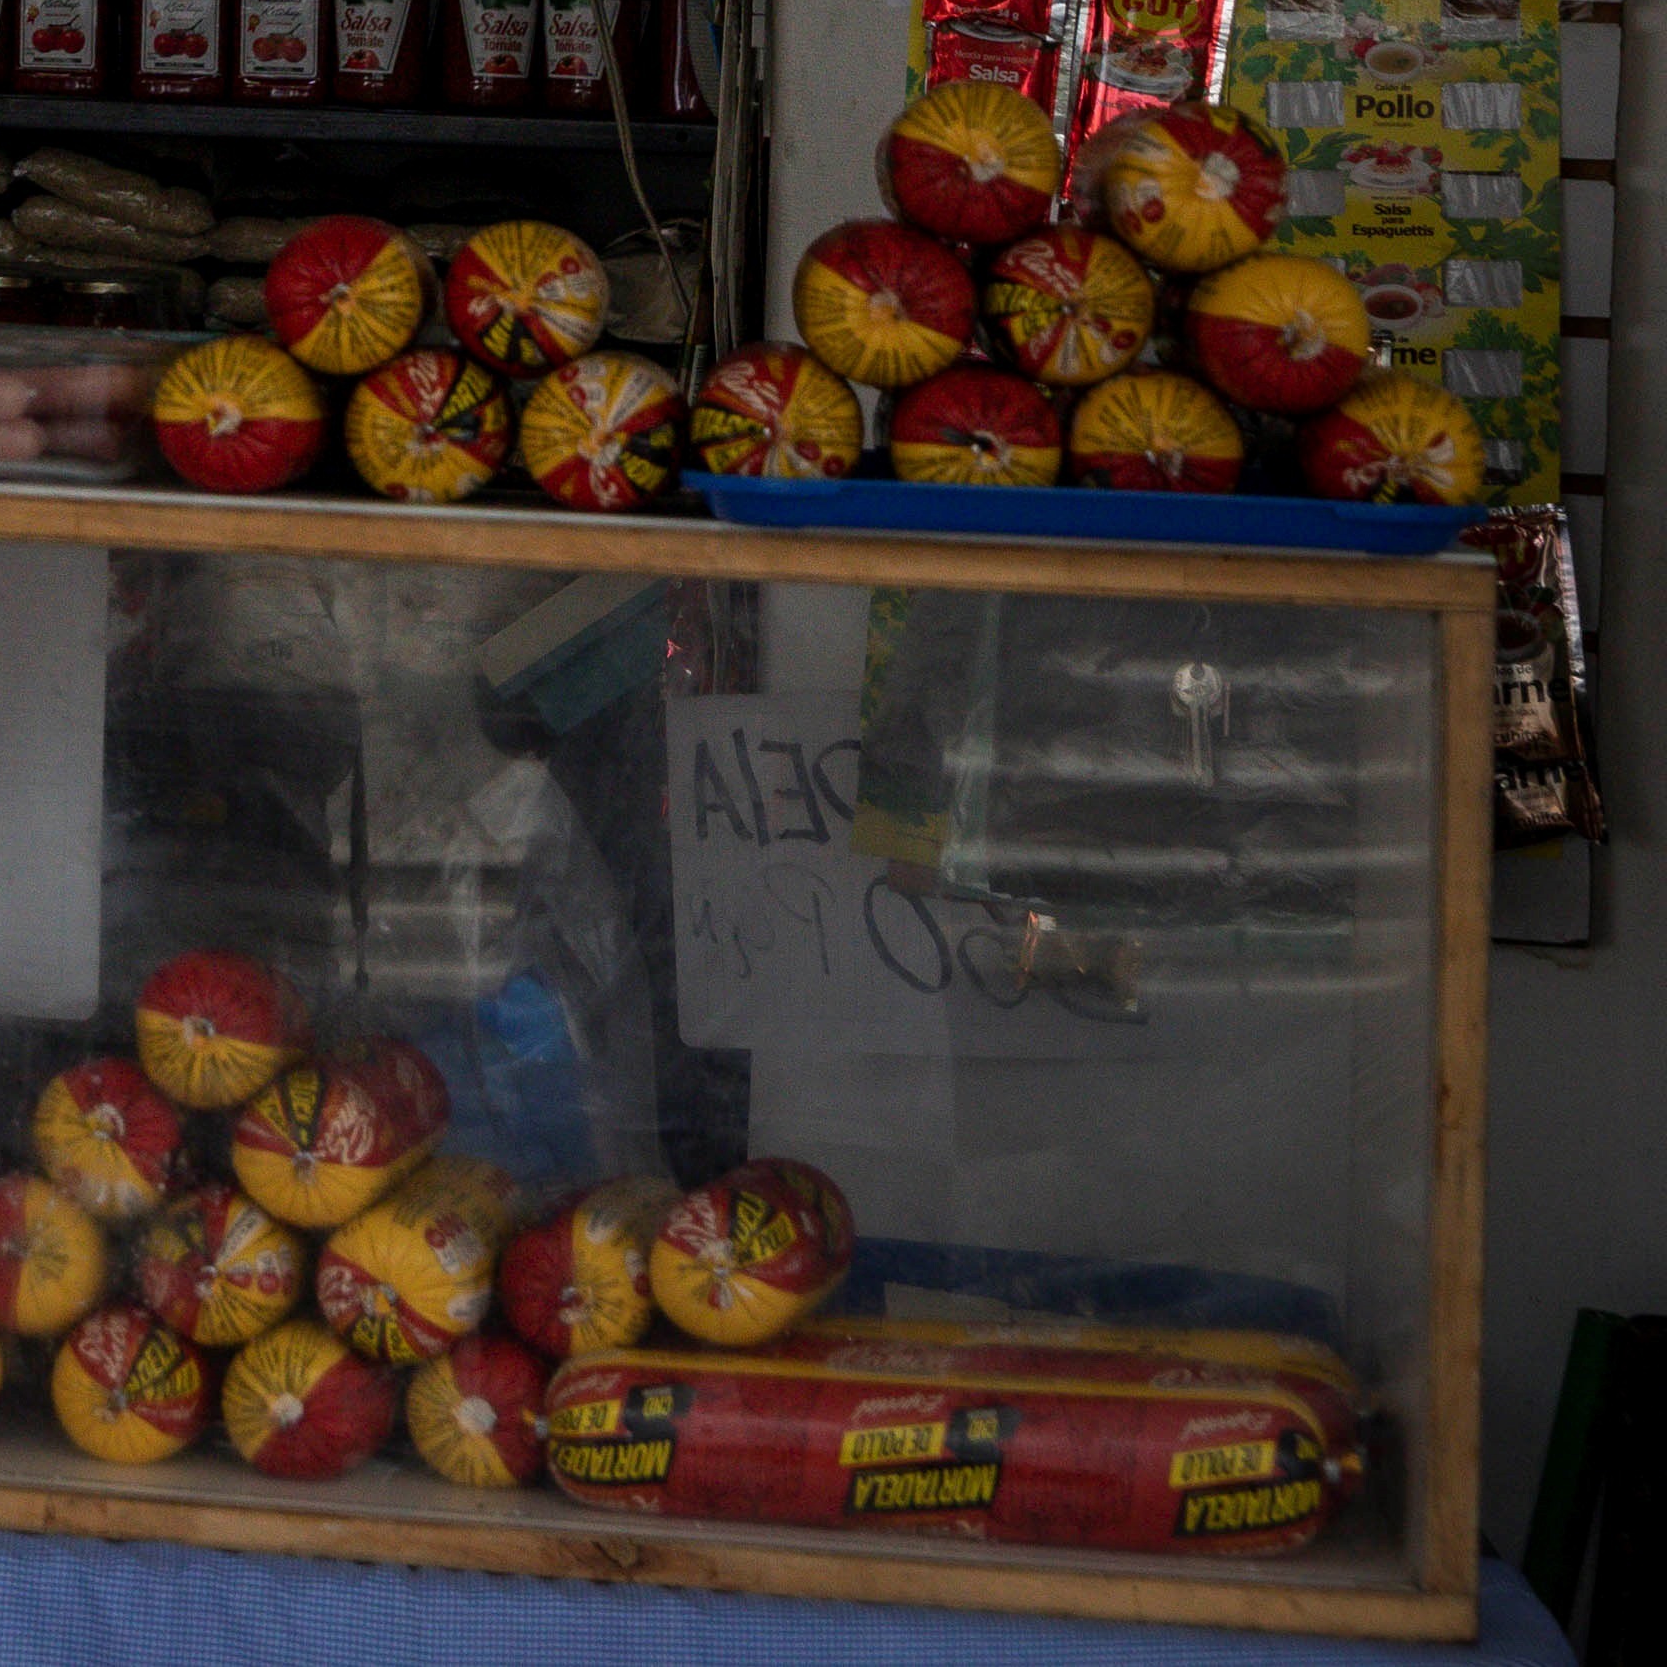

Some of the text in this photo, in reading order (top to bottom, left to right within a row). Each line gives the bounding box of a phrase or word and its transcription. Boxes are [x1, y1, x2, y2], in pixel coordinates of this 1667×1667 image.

[340, 7, 392, 33] Salsa
[473, 12, 529, 37] Salsa
[548, 12, 600, 39] Salsa
[345, 35, 385, 49] Tomate
[482, 37, 524, 52] Tomate
[1355, 93, 1435, 120] Pollo
[1373, 202, 1412, 217] Salsa
[1351, 222, 1435, 238] Espaguettis
[853, 1463, 1000, 1510] MORTADELA
[1184, 1480, 1324, 1533] MORTADELA
